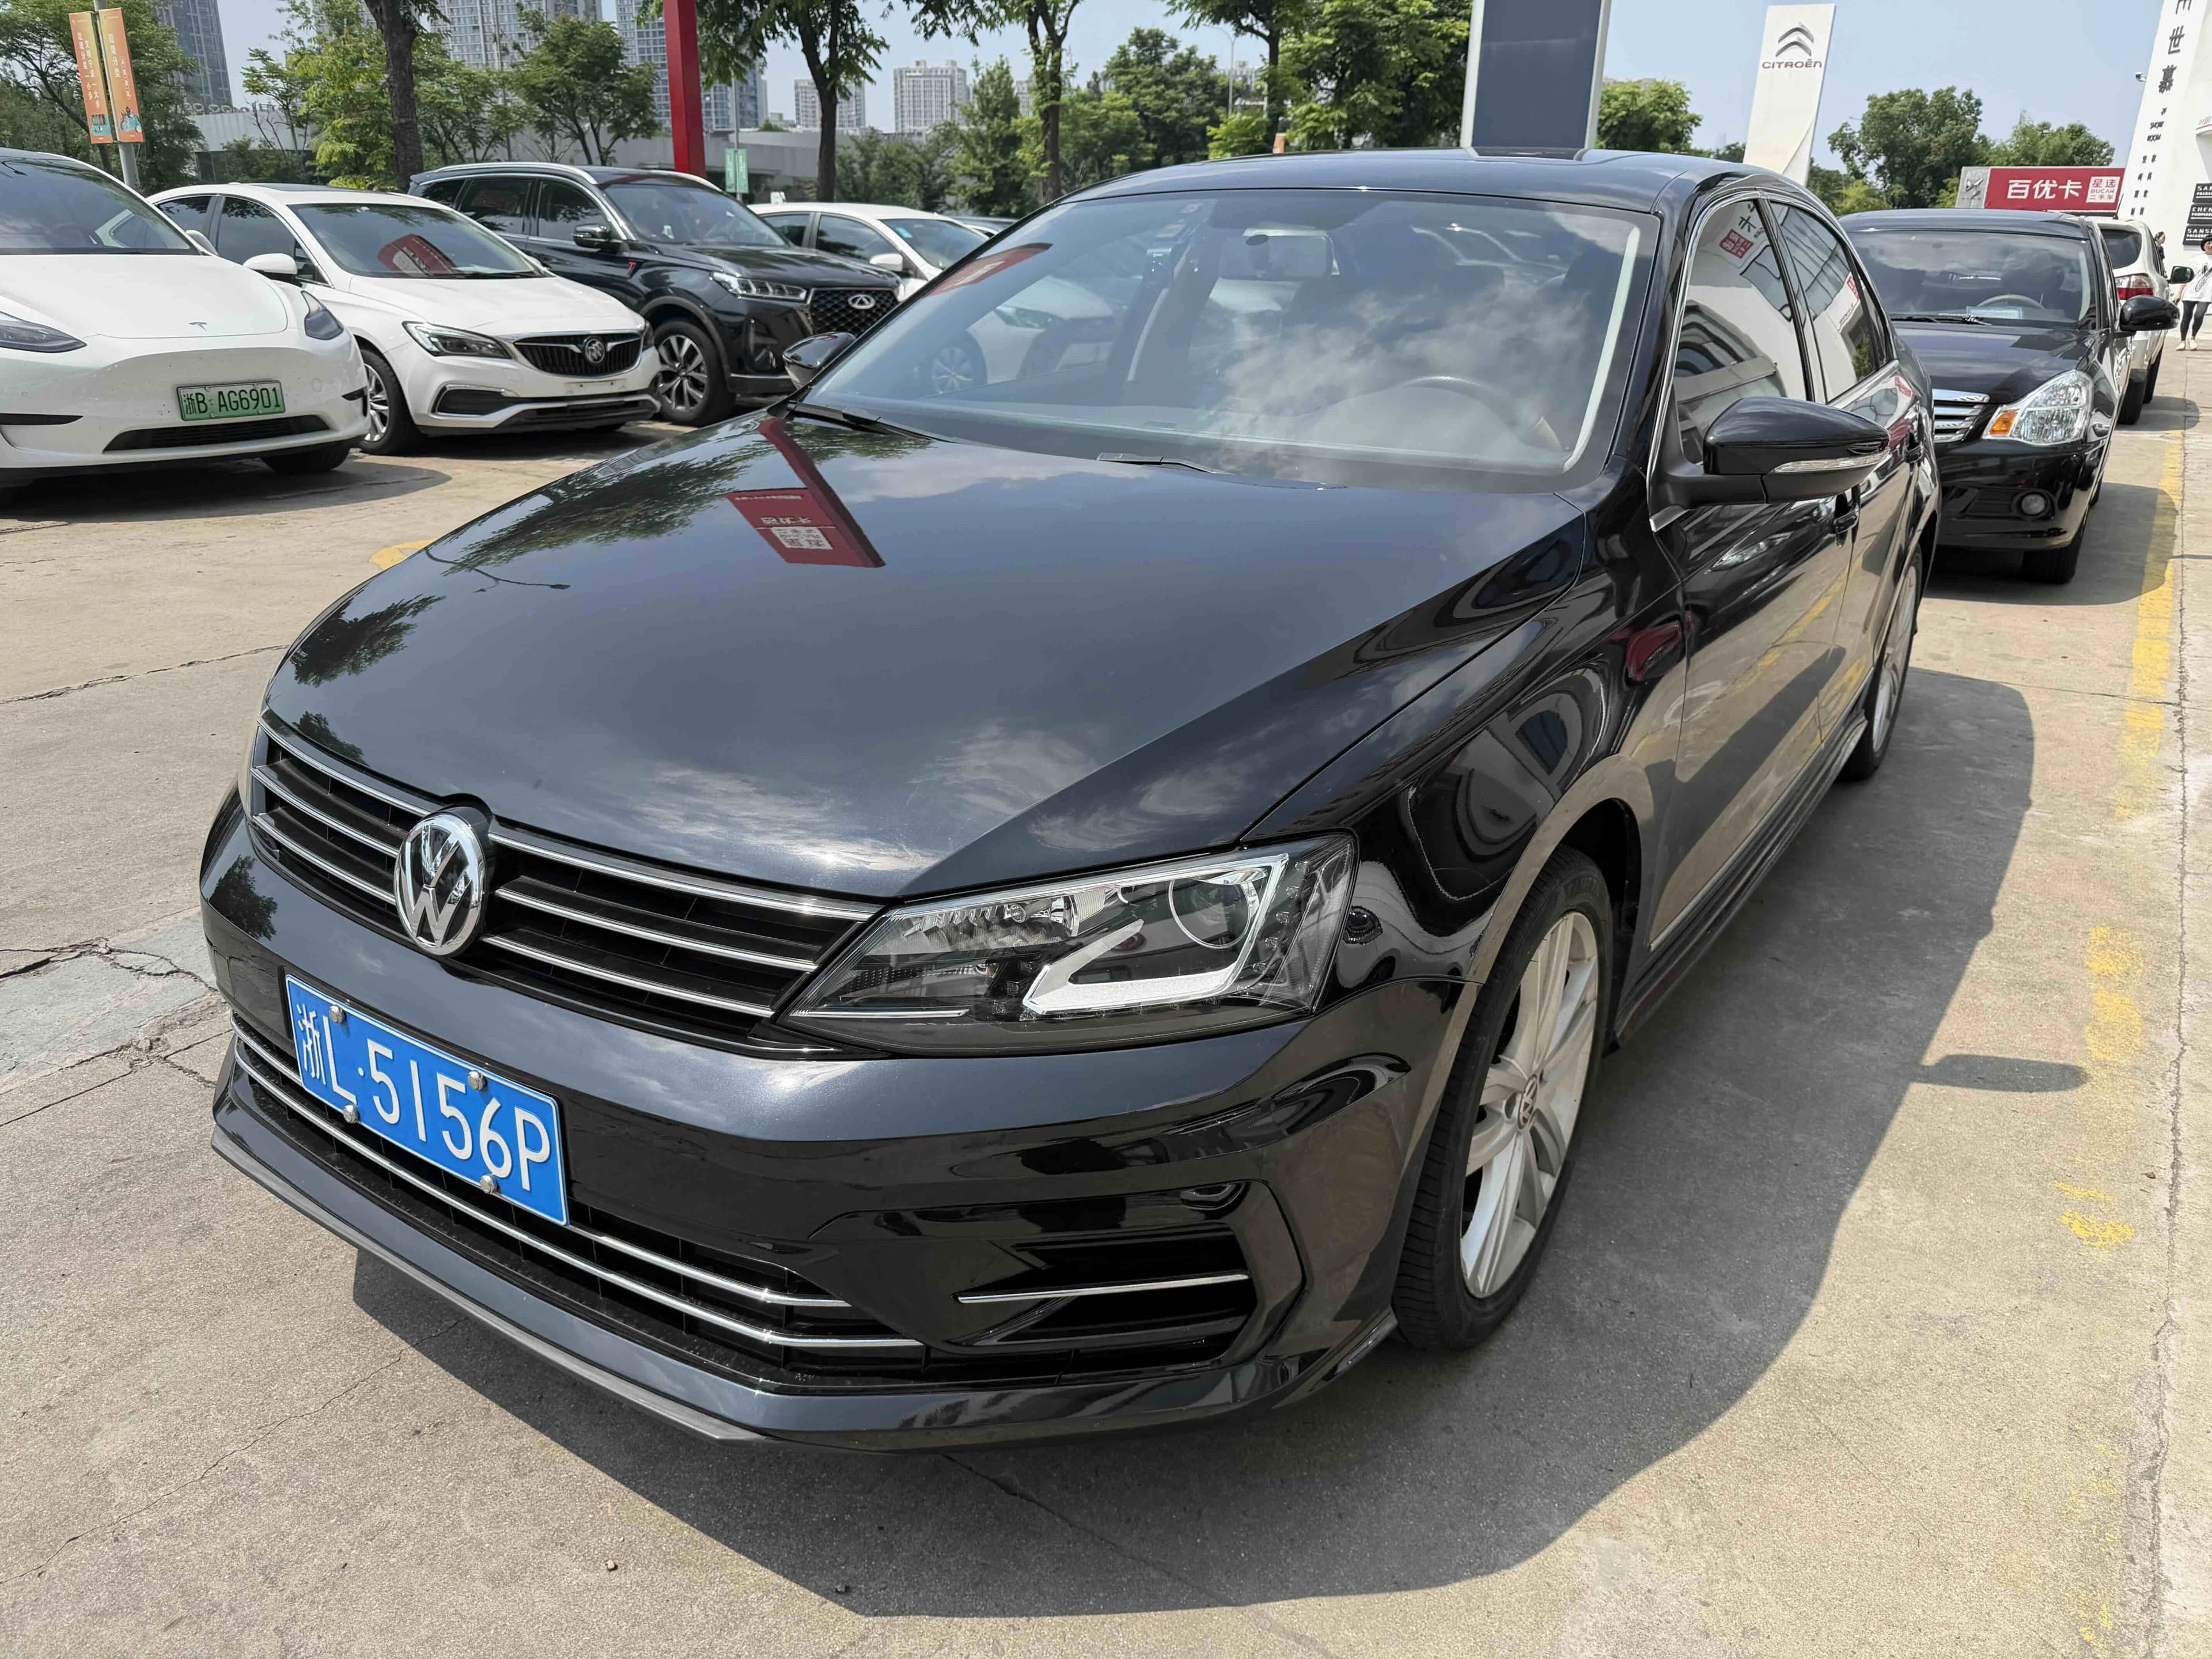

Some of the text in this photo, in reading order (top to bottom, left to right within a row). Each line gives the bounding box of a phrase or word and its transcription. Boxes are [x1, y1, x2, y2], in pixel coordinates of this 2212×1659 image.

[2007, 179, 2082, 199] 百优卡
[2092, 179, 2116, 188] 星选
[218, 387, 281, 412] AG6901
